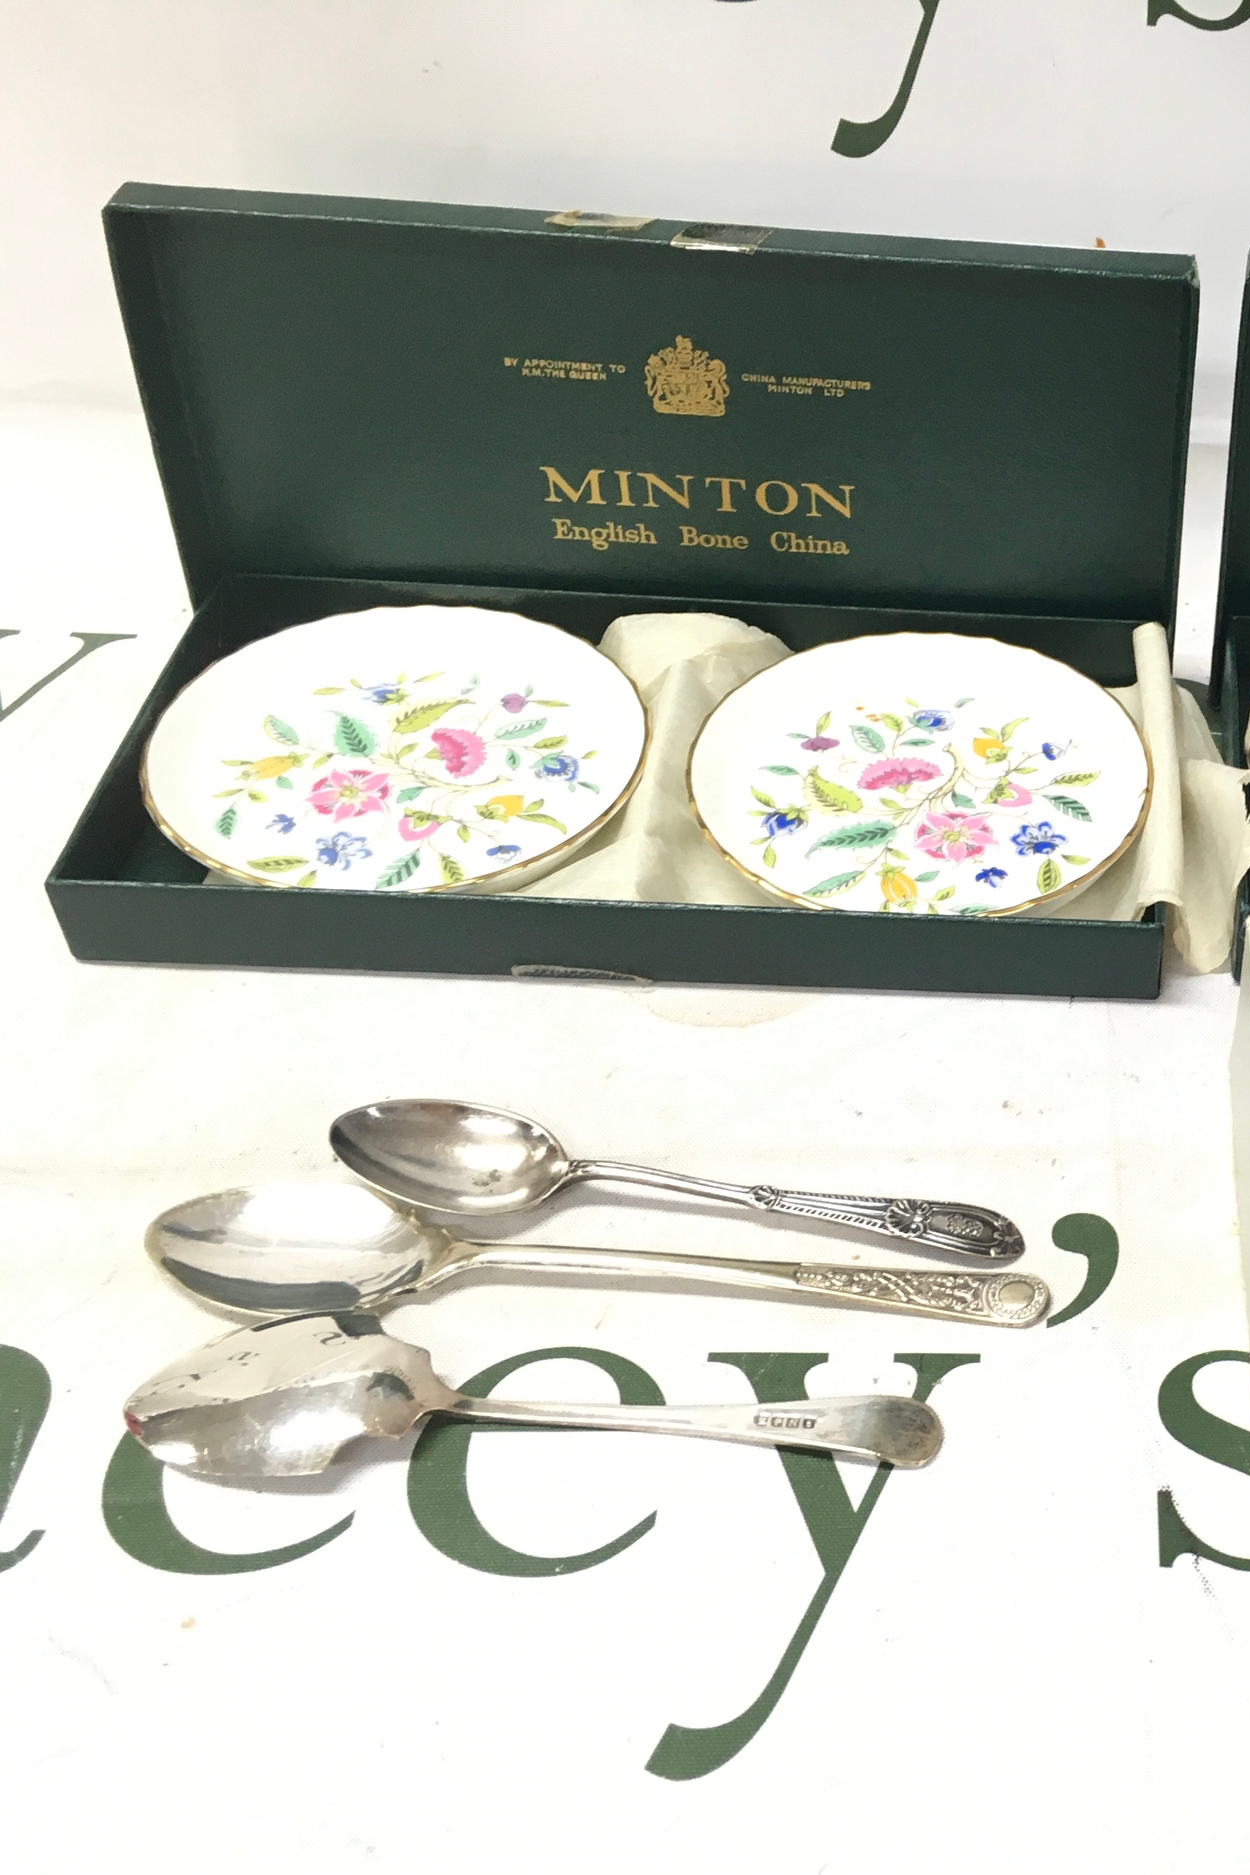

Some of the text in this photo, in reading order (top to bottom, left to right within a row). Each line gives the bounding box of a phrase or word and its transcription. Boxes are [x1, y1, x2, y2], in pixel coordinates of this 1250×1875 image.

[503, 357, 626, 374] BY APPOINTMENT TO
[569, 370, 607, 382] QUEEN
[741, 373, 871, 391] CHINA MANUFACTURERS
[767, 384, 844, 397] MINTON LTD
[539, 465, 855, 519] MINTON
[551, 516, 851, 556] English Bone China
